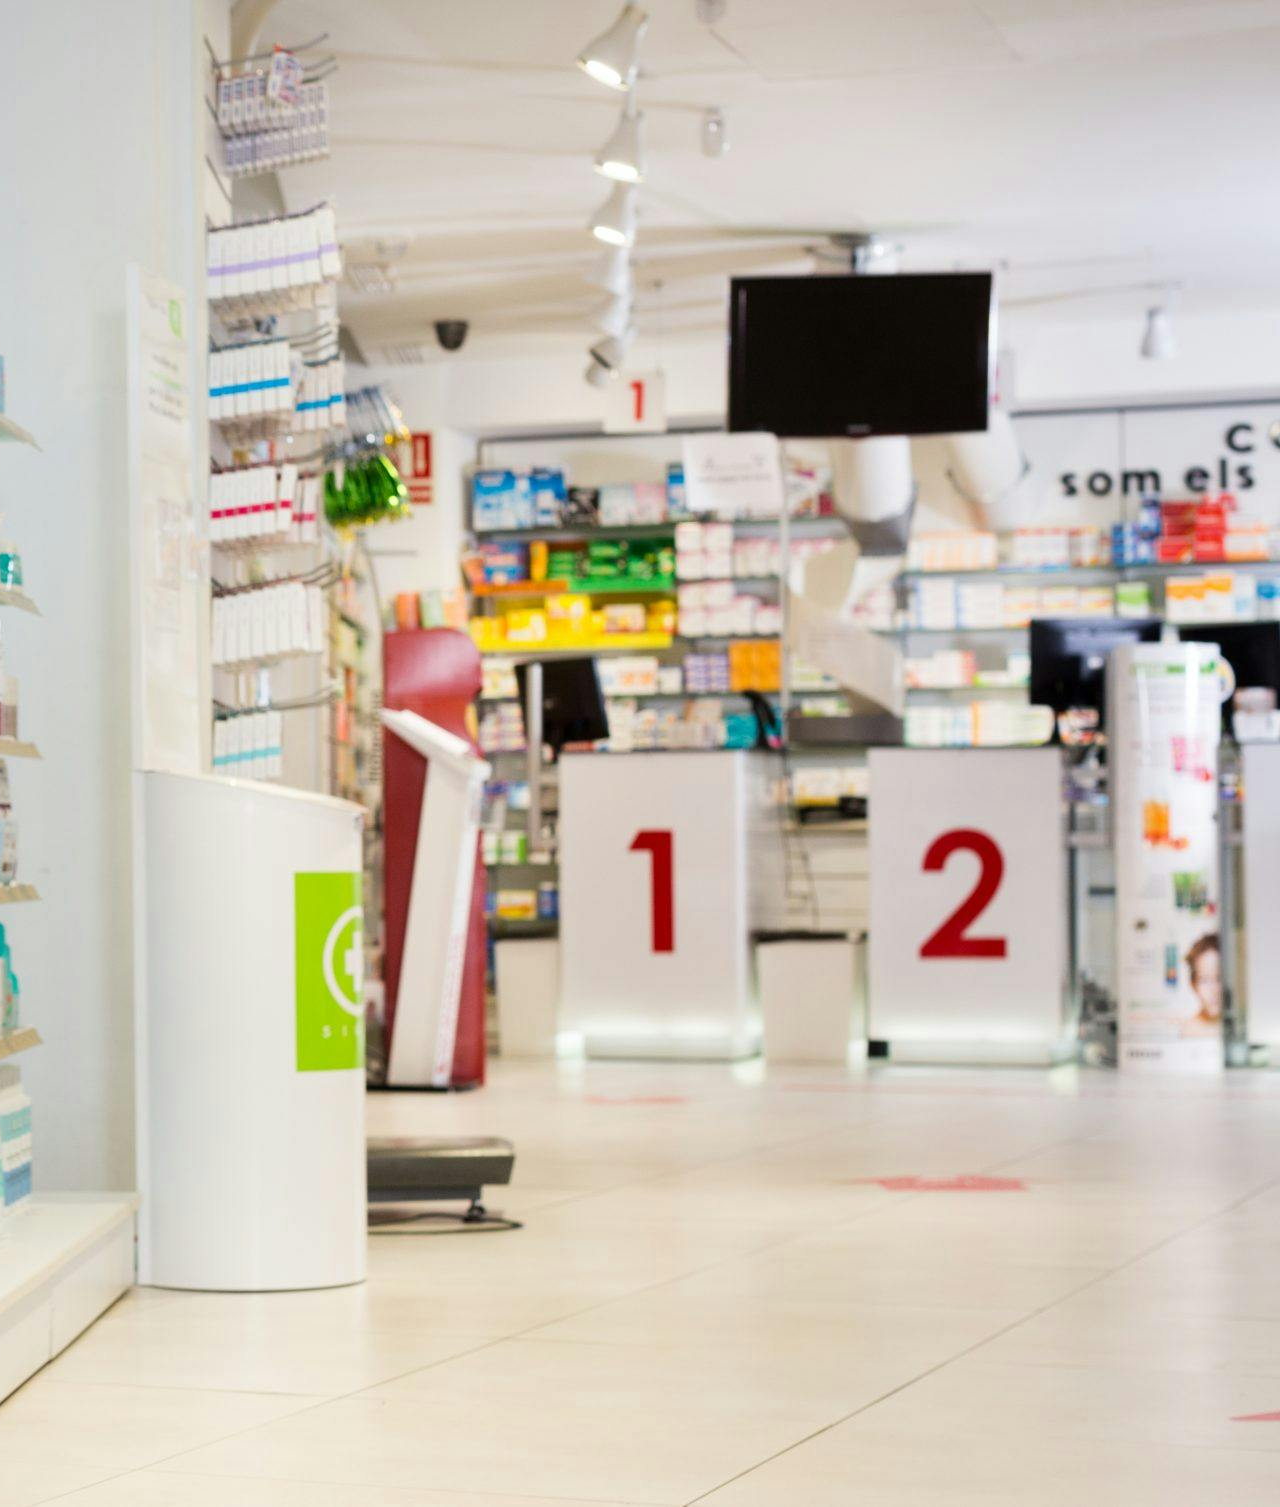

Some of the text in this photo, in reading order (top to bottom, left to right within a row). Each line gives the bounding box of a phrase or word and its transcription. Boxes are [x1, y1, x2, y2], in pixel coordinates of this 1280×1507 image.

[631, 381, 644, 421] 1
[1061, 459, 1254, 496] som els
[629, 828, 674, 953] 1
[919, 828, 1007, 960] 2
